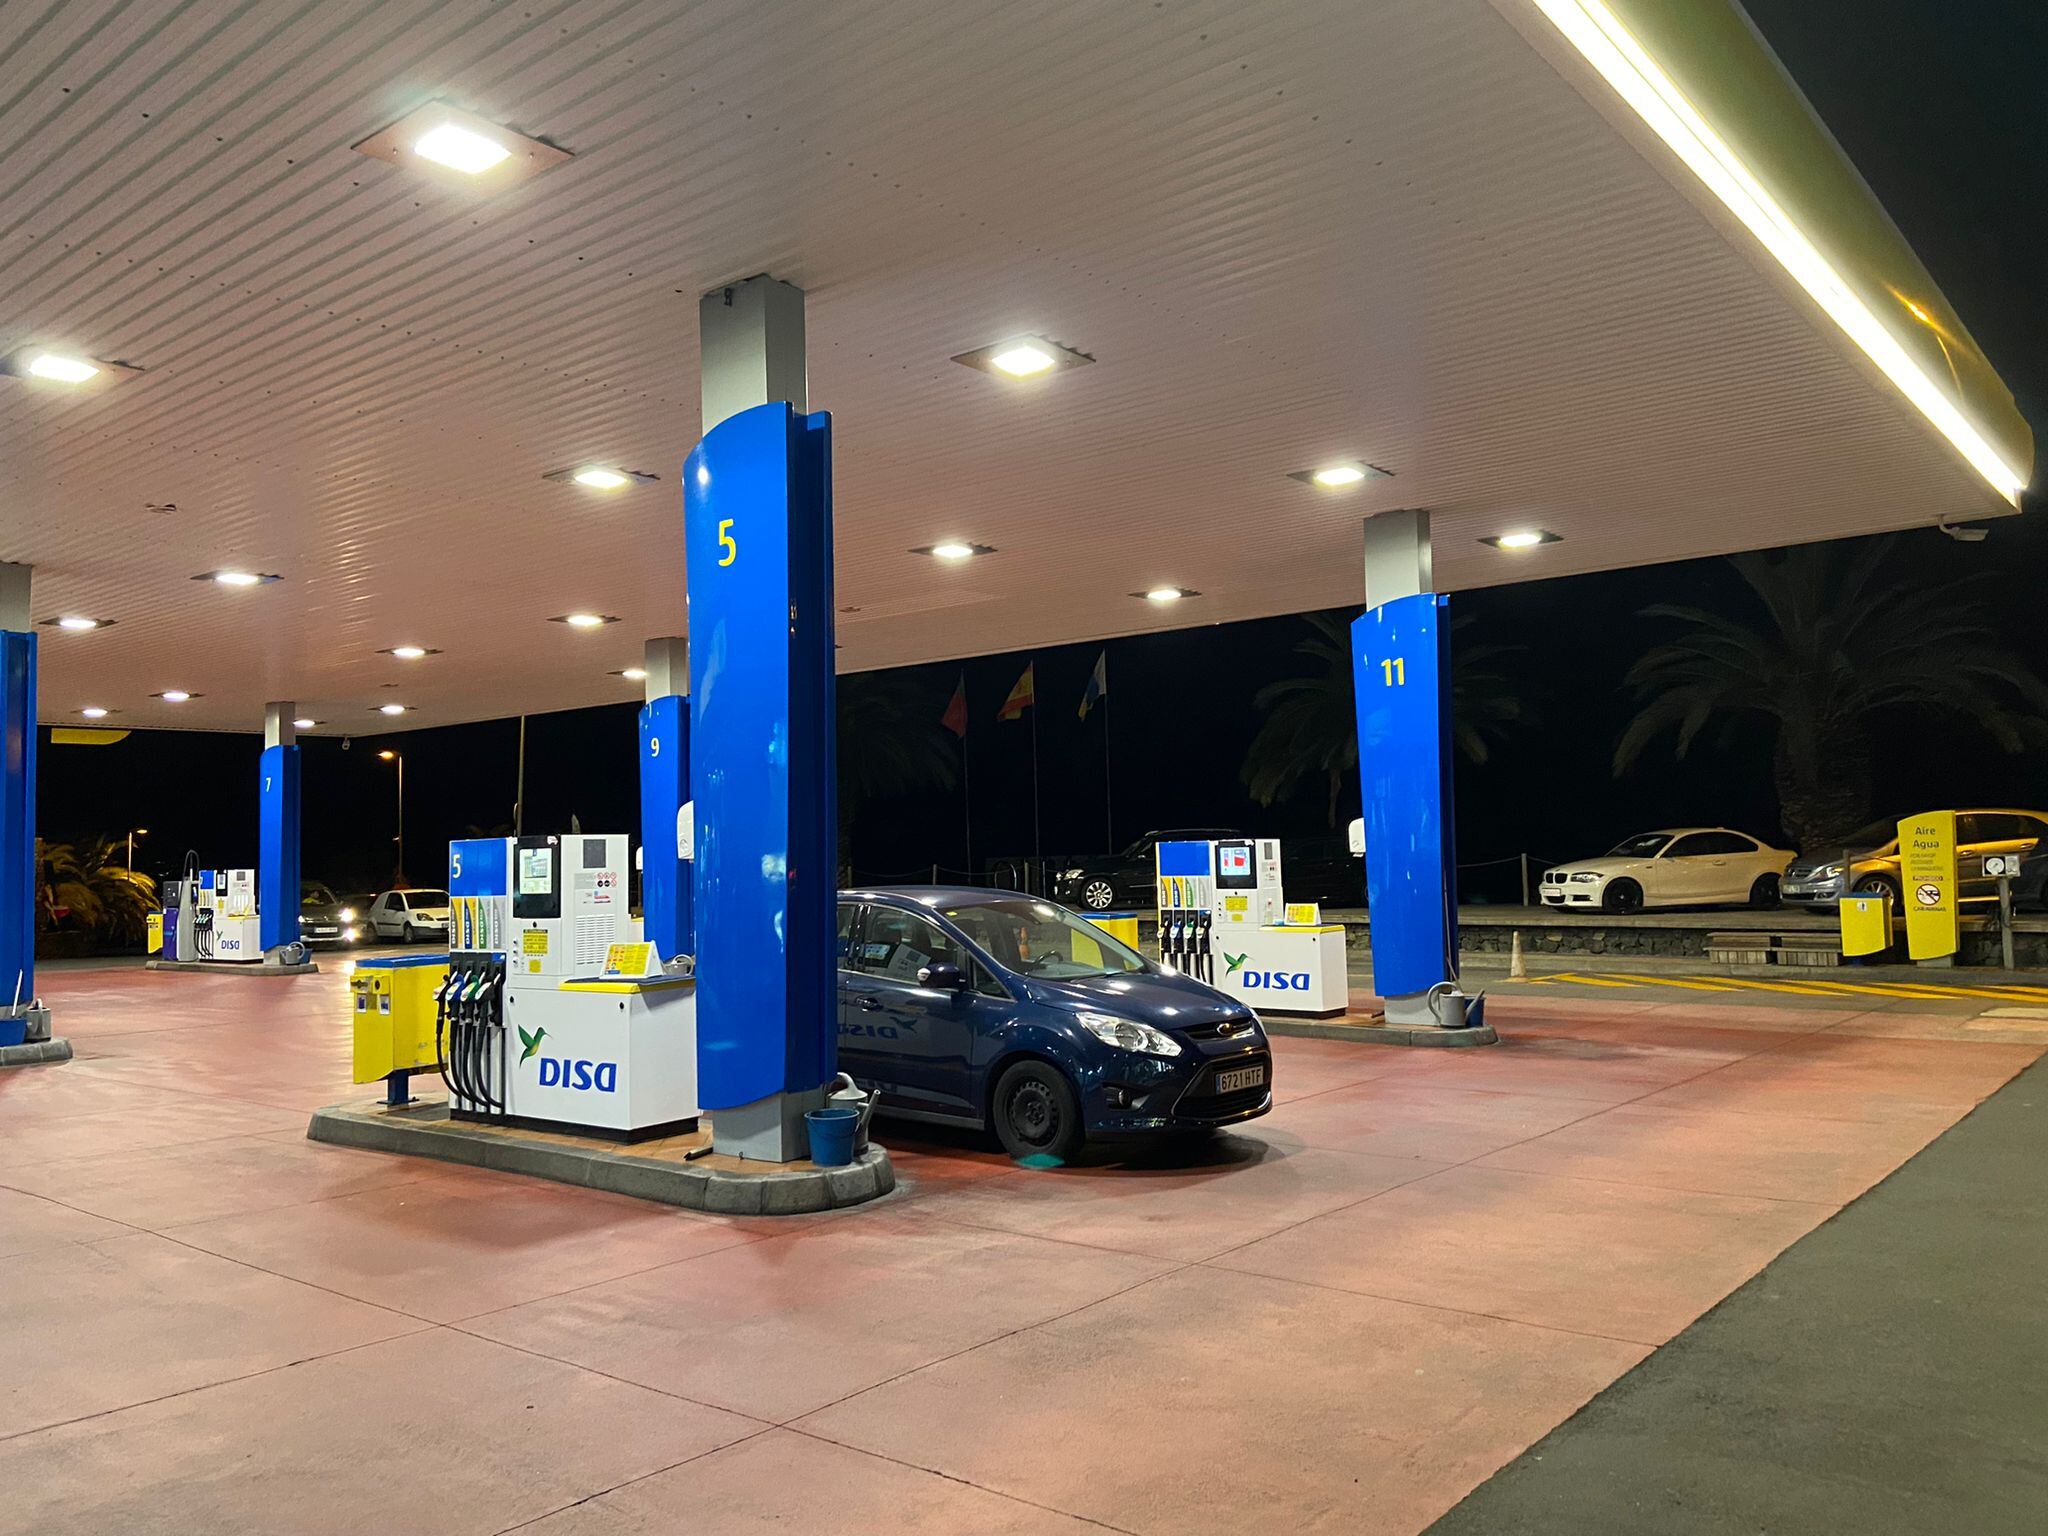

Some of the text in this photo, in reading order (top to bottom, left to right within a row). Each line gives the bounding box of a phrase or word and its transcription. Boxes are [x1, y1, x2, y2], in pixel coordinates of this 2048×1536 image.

[718, 518, 737, 567] 5
[1381, 657, 1405, 687] 11
[650, 737, 660, 758] 9
[265, 777, 272, 793] 7
[1915, 827, 1936, 835] Aire
[1913, 840, 1939, 849] Agua
[453, 854, 461, 878] 5
